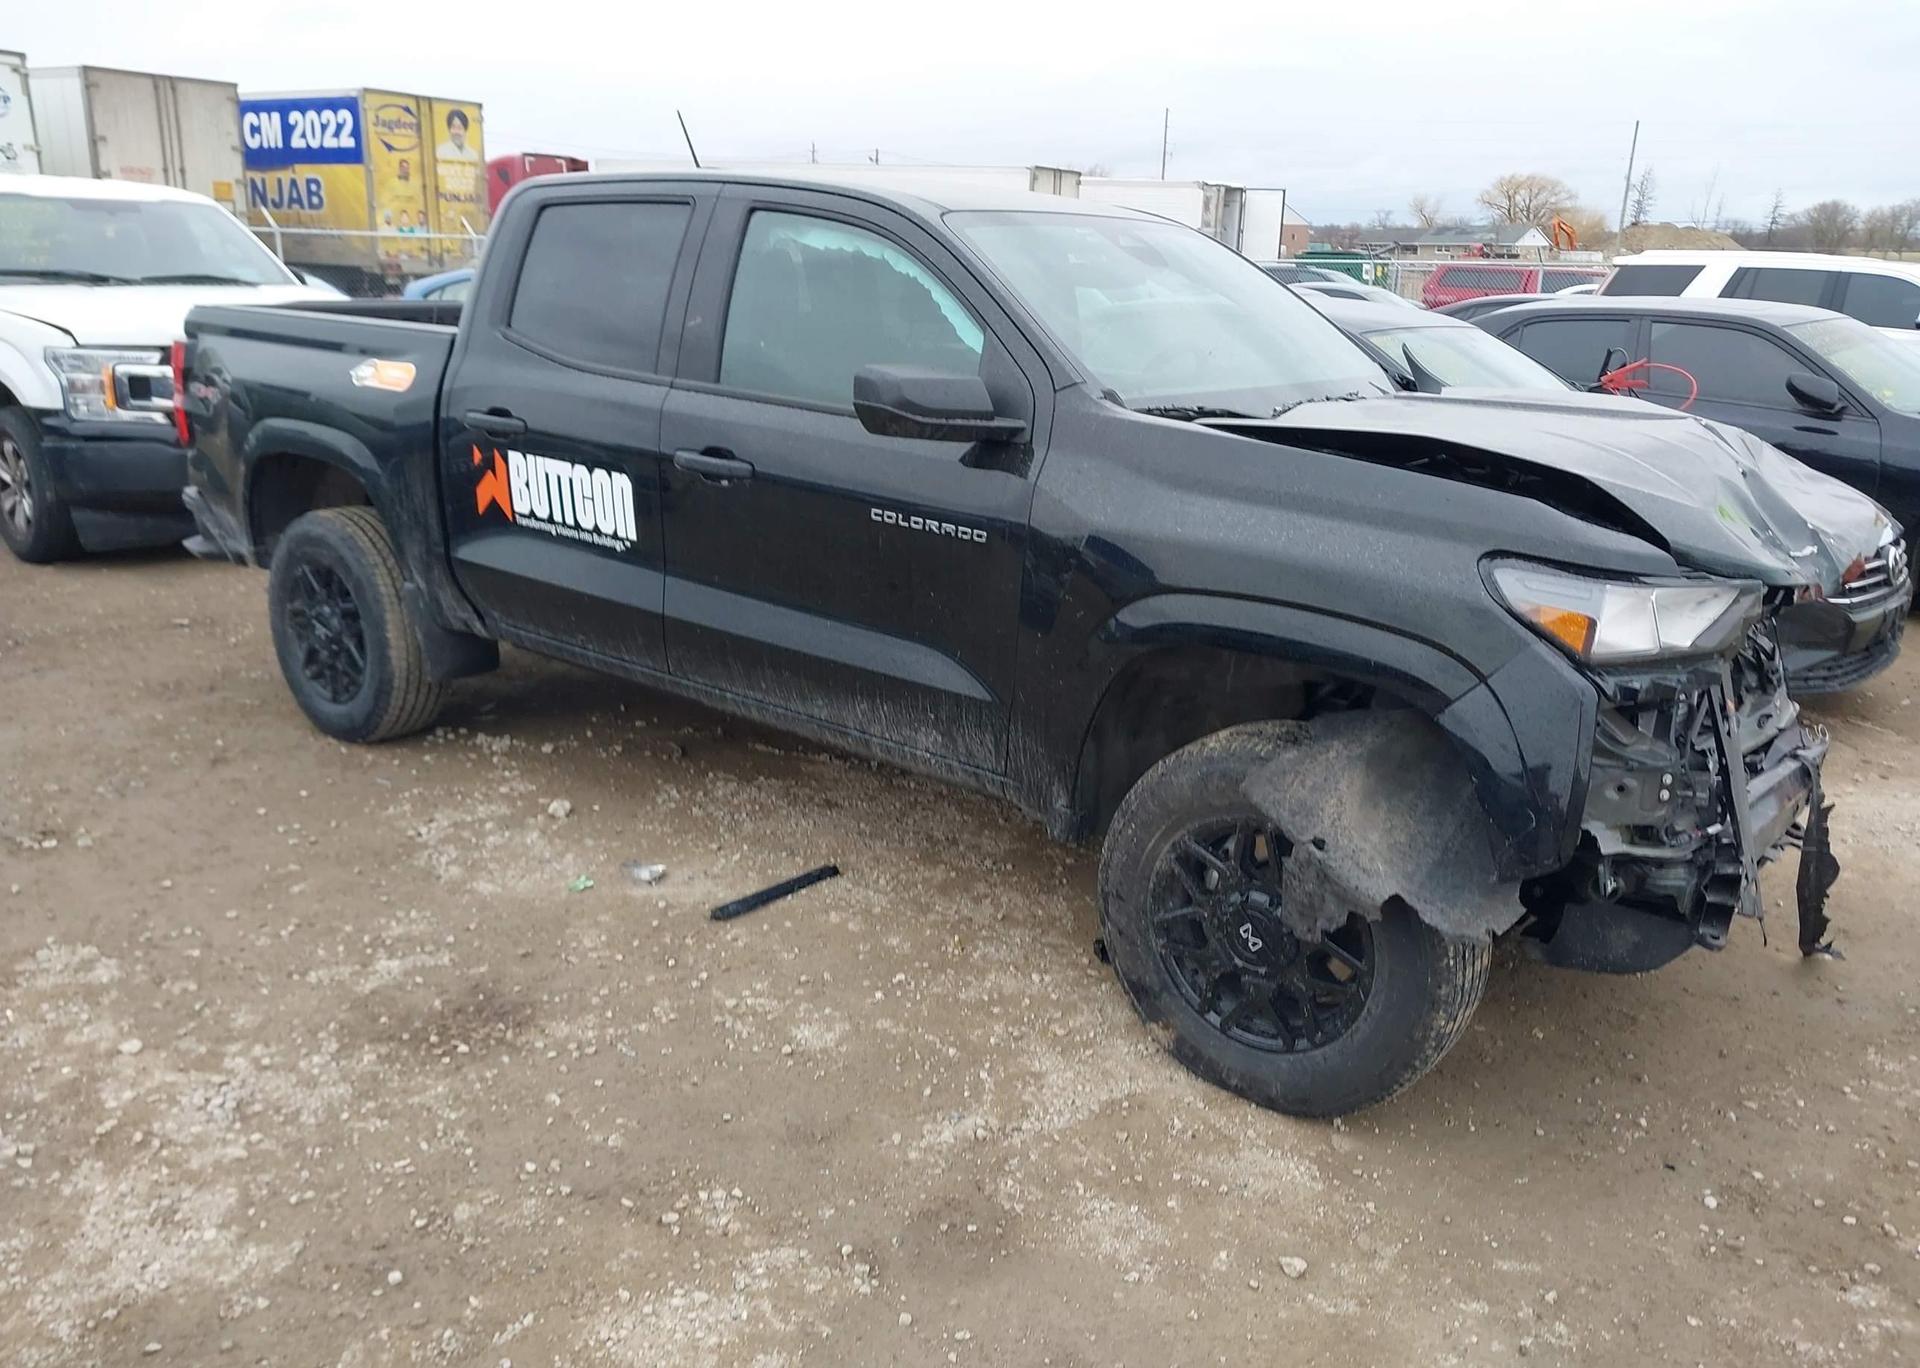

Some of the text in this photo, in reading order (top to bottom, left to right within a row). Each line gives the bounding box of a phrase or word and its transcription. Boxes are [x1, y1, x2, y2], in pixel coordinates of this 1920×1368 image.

[242, 108, 355, 149] CM 2022
[249, 176, 324, 211] NJAB
[507, 449, 637, 542] BUTTCON
[515, 514, 557, 536] Transforming
[870, 507, 987, 543] COLORADO
